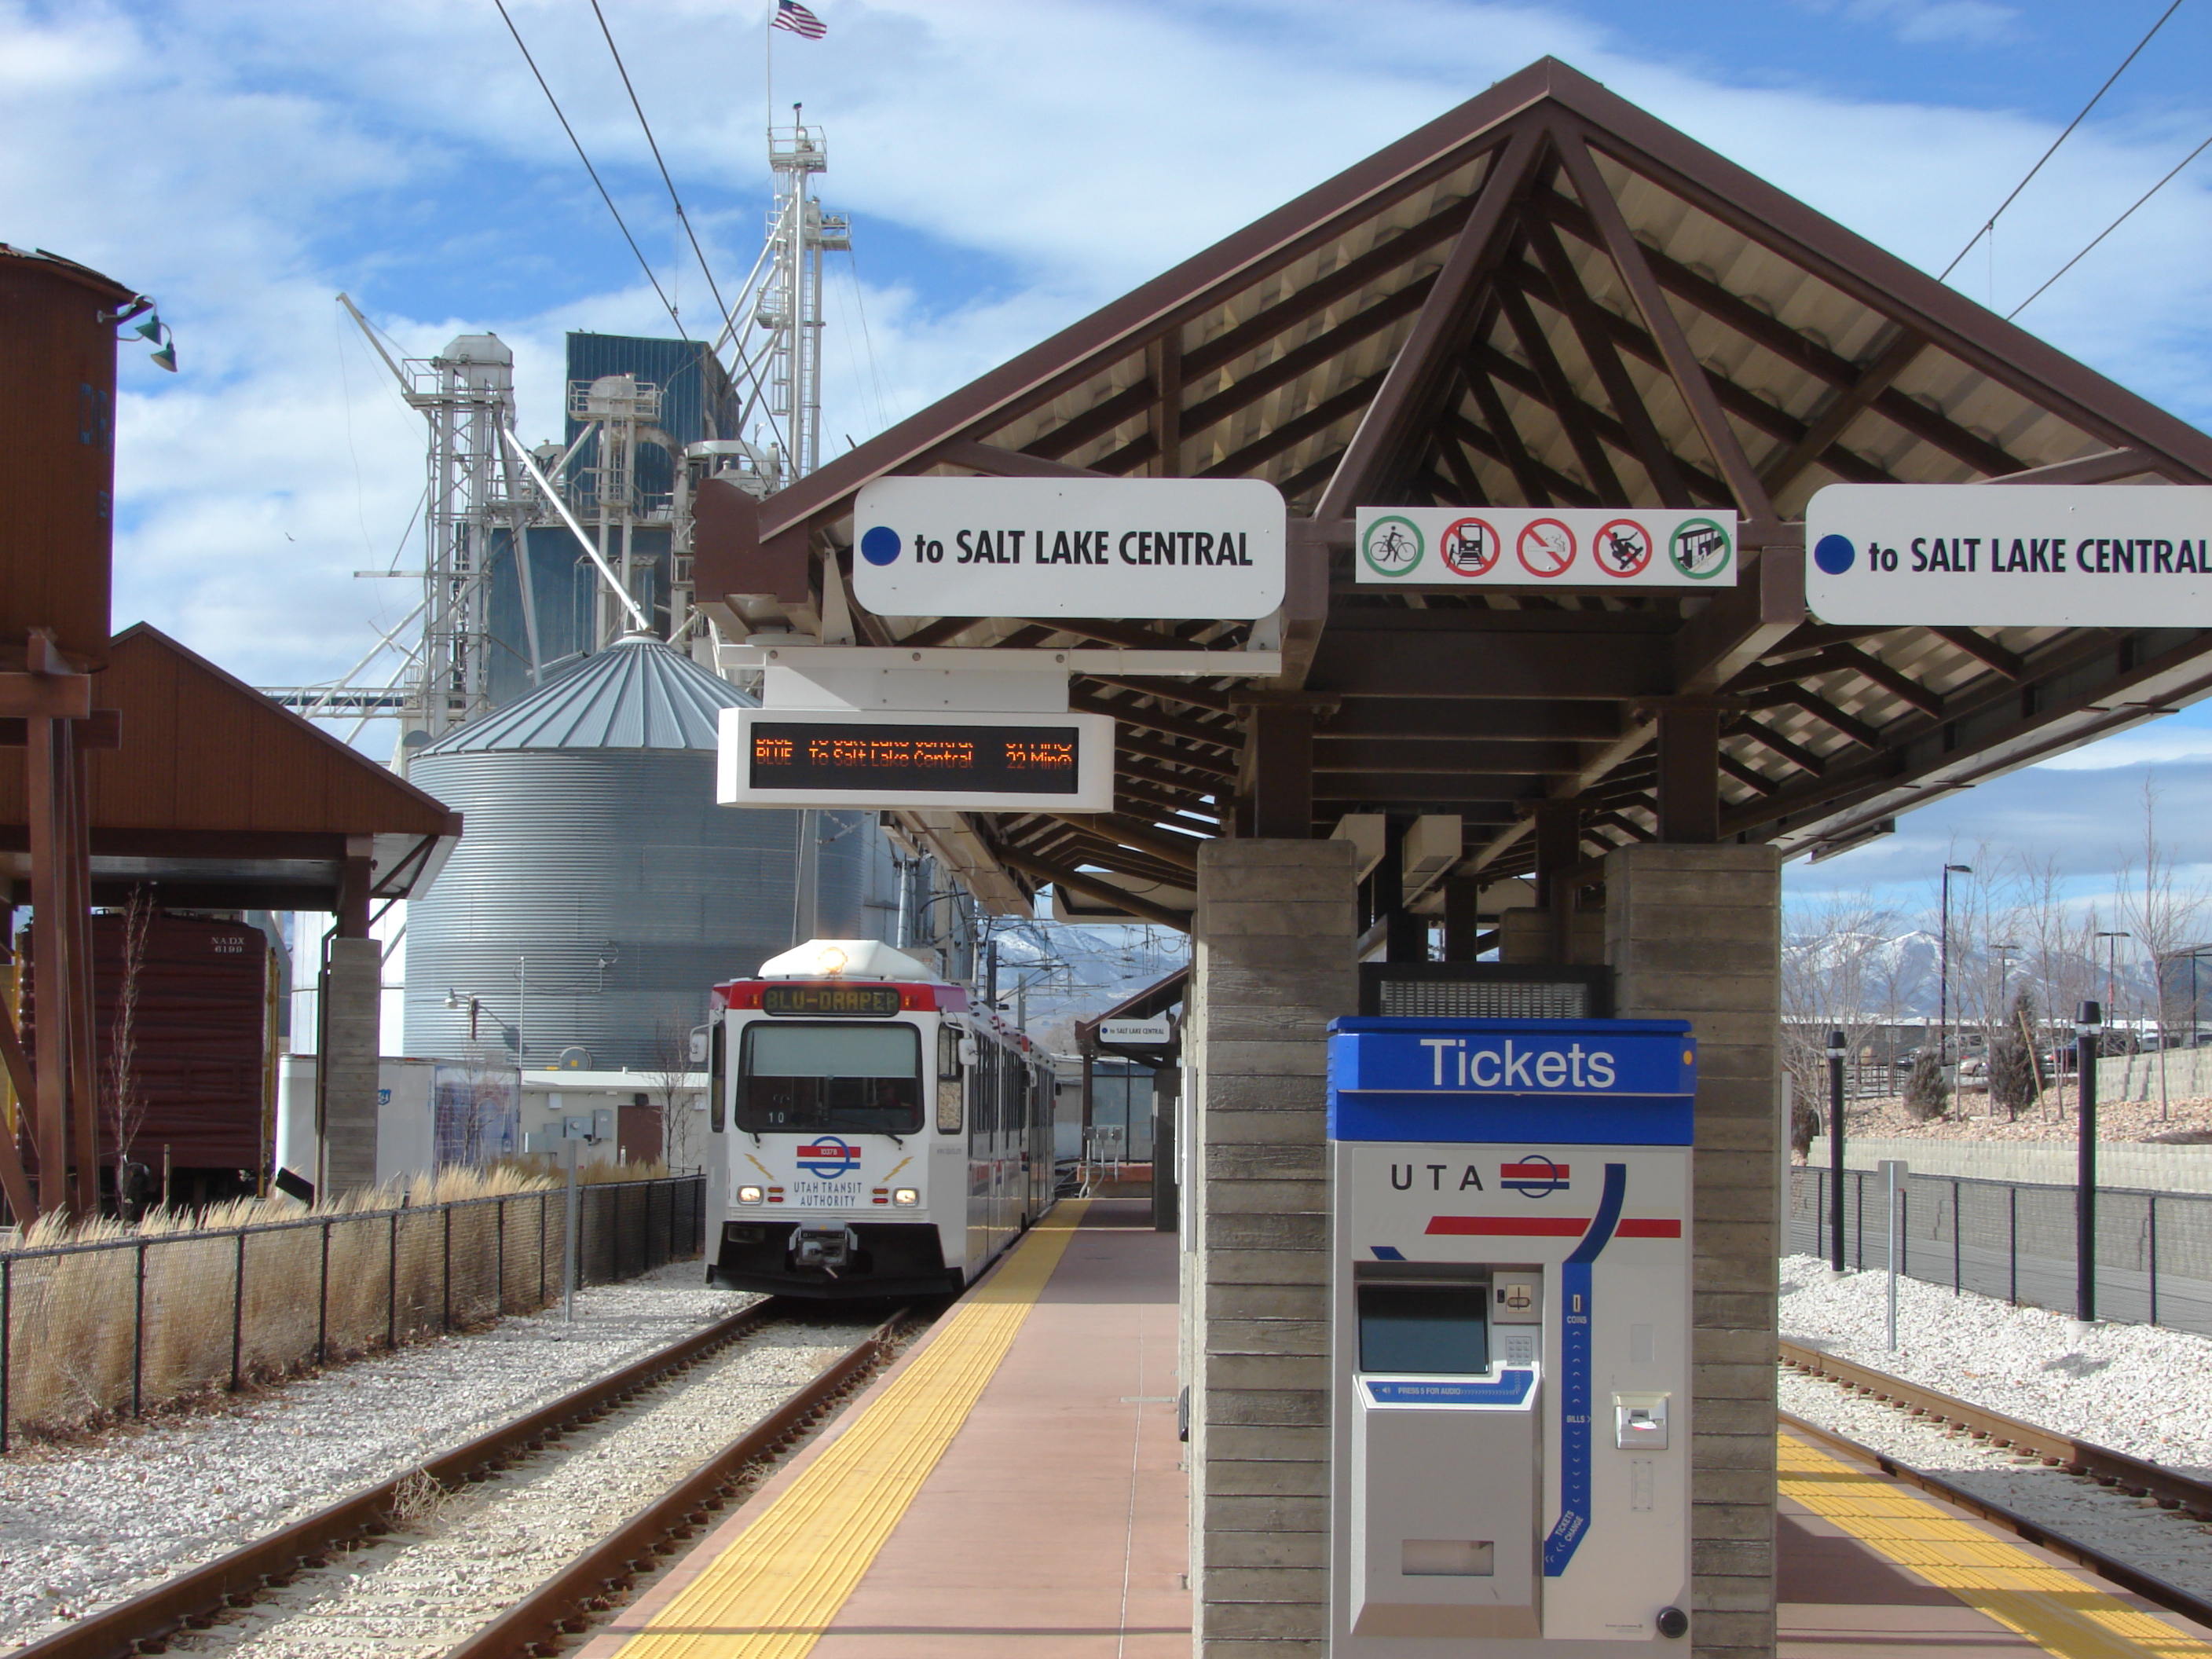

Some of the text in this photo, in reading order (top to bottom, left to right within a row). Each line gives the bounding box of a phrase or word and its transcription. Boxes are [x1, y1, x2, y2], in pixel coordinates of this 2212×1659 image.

[914, 529, 1253, 566] to SALT LAKE CENTRAL
[1869, 537, 2212, 573] to SALT LAKE CENTRAL
[211, 936, 245, 945] NADX
[1421, 1039, 1615, 1088] Tickets
[793, 1181, 862, 1194] UTAH TRANSIT
[1391, 1164, 1484, 1192] UTA
[800, 1195, 856, 1207] AUTHORITY
[1566, 1316, 1588, 1324] COINS
[1397, 1386, 1420, 1395] PRESS
[1566, 1415, 1585, 1423] BILLS
[1555, 1510, 1575, 1536] TICKETS
[1564, 1515, 1584, 1542] CHANGE
